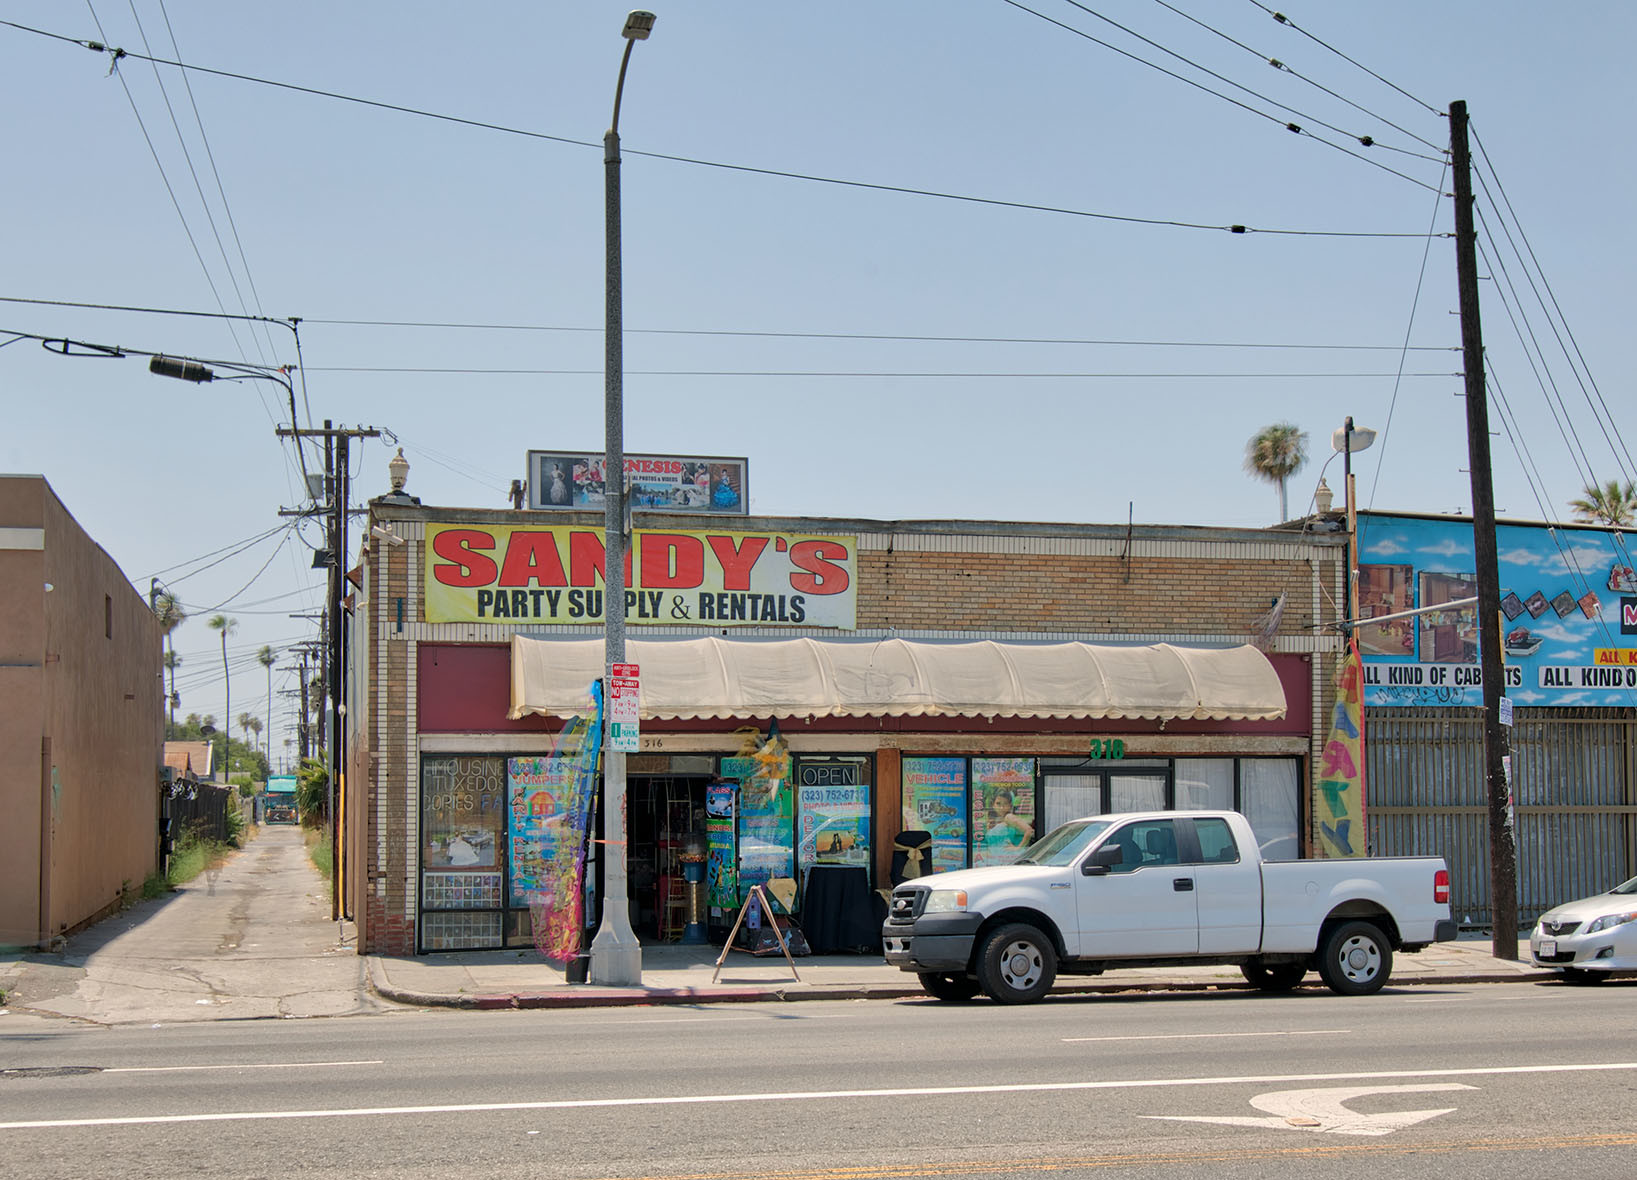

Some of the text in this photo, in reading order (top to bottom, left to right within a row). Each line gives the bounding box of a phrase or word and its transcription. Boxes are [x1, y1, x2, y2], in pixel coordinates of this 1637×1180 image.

[433, 529, 850, 595] SANDY'S
[478, 589, 806, 623] PARTY SUPLY & RENTALS
[1600, 651, 1619, 663] ALL
[1389, 666, 1423, 685] KIND
[1430, 667, 1447, 685] OF
[1455, 667, 1521, 686] CABTS
[1544, 667, 1573, 686] ALL
[1582, 668, 1623, 687] KIND
[611, 687, 620, 696] NO
[644, 739, 663, 748] 316
[803, 767, 855, 786] OPEN
[906, 773, 964, 785] VEHICLE
[801, 790, 823, 802] (323)
